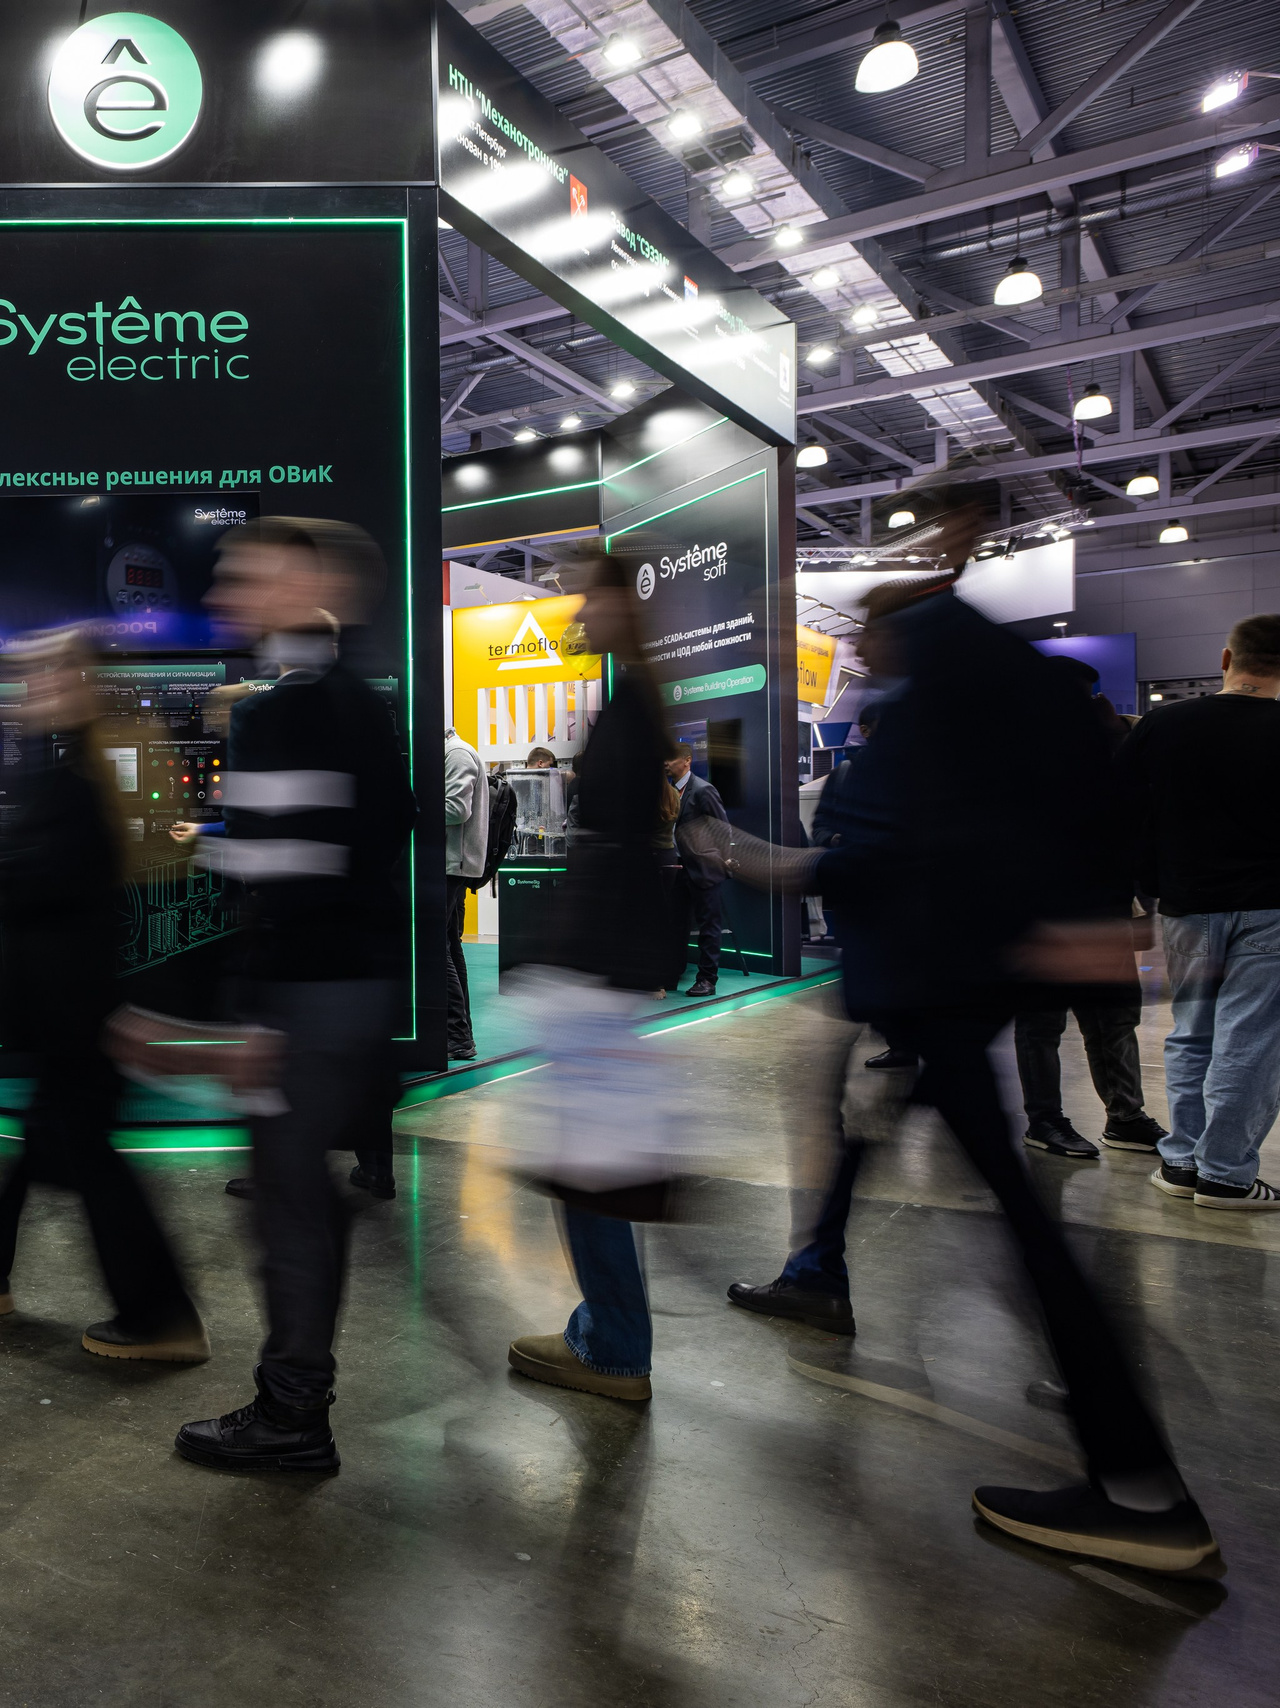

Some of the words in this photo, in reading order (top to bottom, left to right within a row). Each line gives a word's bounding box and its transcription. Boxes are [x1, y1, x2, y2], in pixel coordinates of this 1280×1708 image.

[448, 63, 475, 110] НТЦ
[66, 346, 250, 382] electric
[105, 468, 213, 491] решения
[218, 466, 262, 489] для
[268, 465, 333, 485] ОВиК
[194, 507, 247, 520] Systême
[210, 517, 247, 526] electric
[659, 541, 728, 580] Systême
[703, 559, 728, 582] soft
[712, 623, 726, 635] для
[488, 637, 561, 656] termoflo
[676, 644, 691, 659] ЦОД
[691, 637, 714, 654] любой
[713, 631, 752, 649] сложности
[248, 683, 276, 692] Systê
[704, 678, 727, 693] Building
[726, 675, 755, 691] Operation
